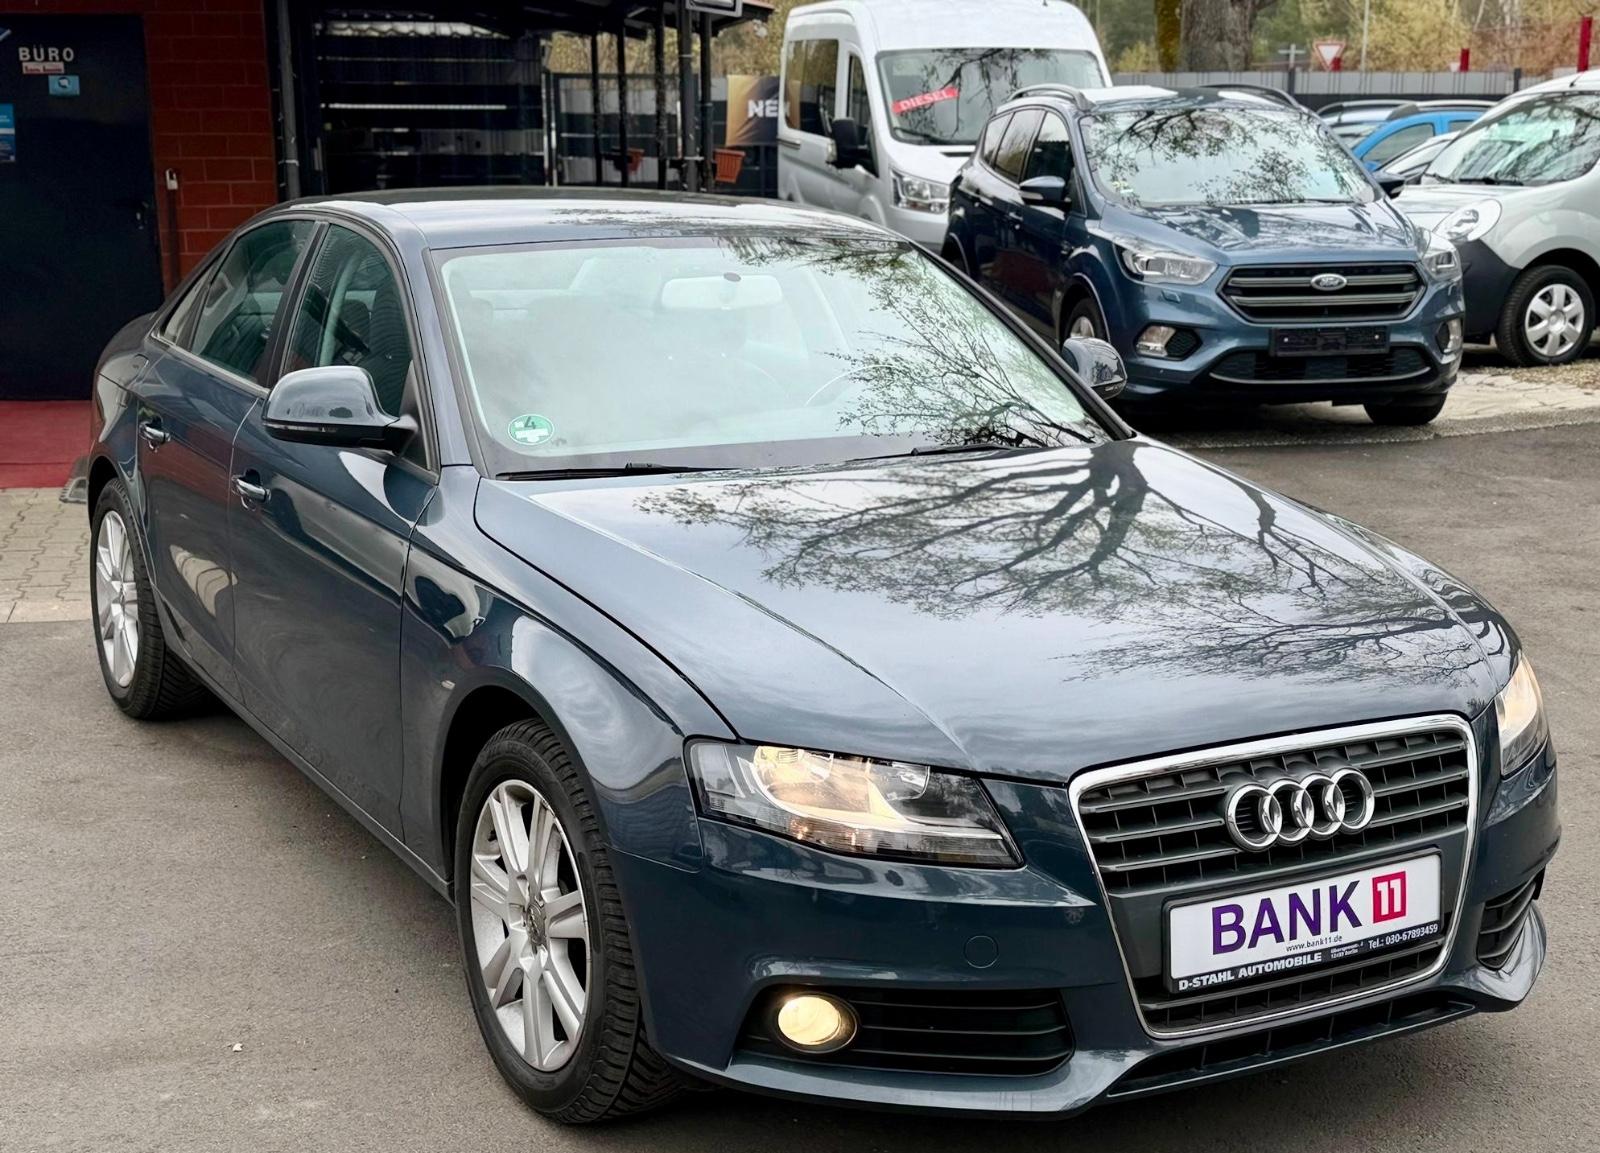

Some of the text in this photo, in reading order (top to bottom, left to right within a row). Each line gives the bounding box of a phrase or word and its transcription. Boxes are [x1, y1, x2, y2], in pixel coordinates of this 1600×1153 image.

[899, 89, 949, 112] DIESEL
[1211, 877, 1403, 955] BANK 11
[1285, 934, 1343, 952] www.bank11.de
[1368, 939, 1384, 950] Tel.:
[1385, 923, 1439, 945] 030-67893459
[1178, 952, 1322, 991] D-STAHL AUTOMOBILE
